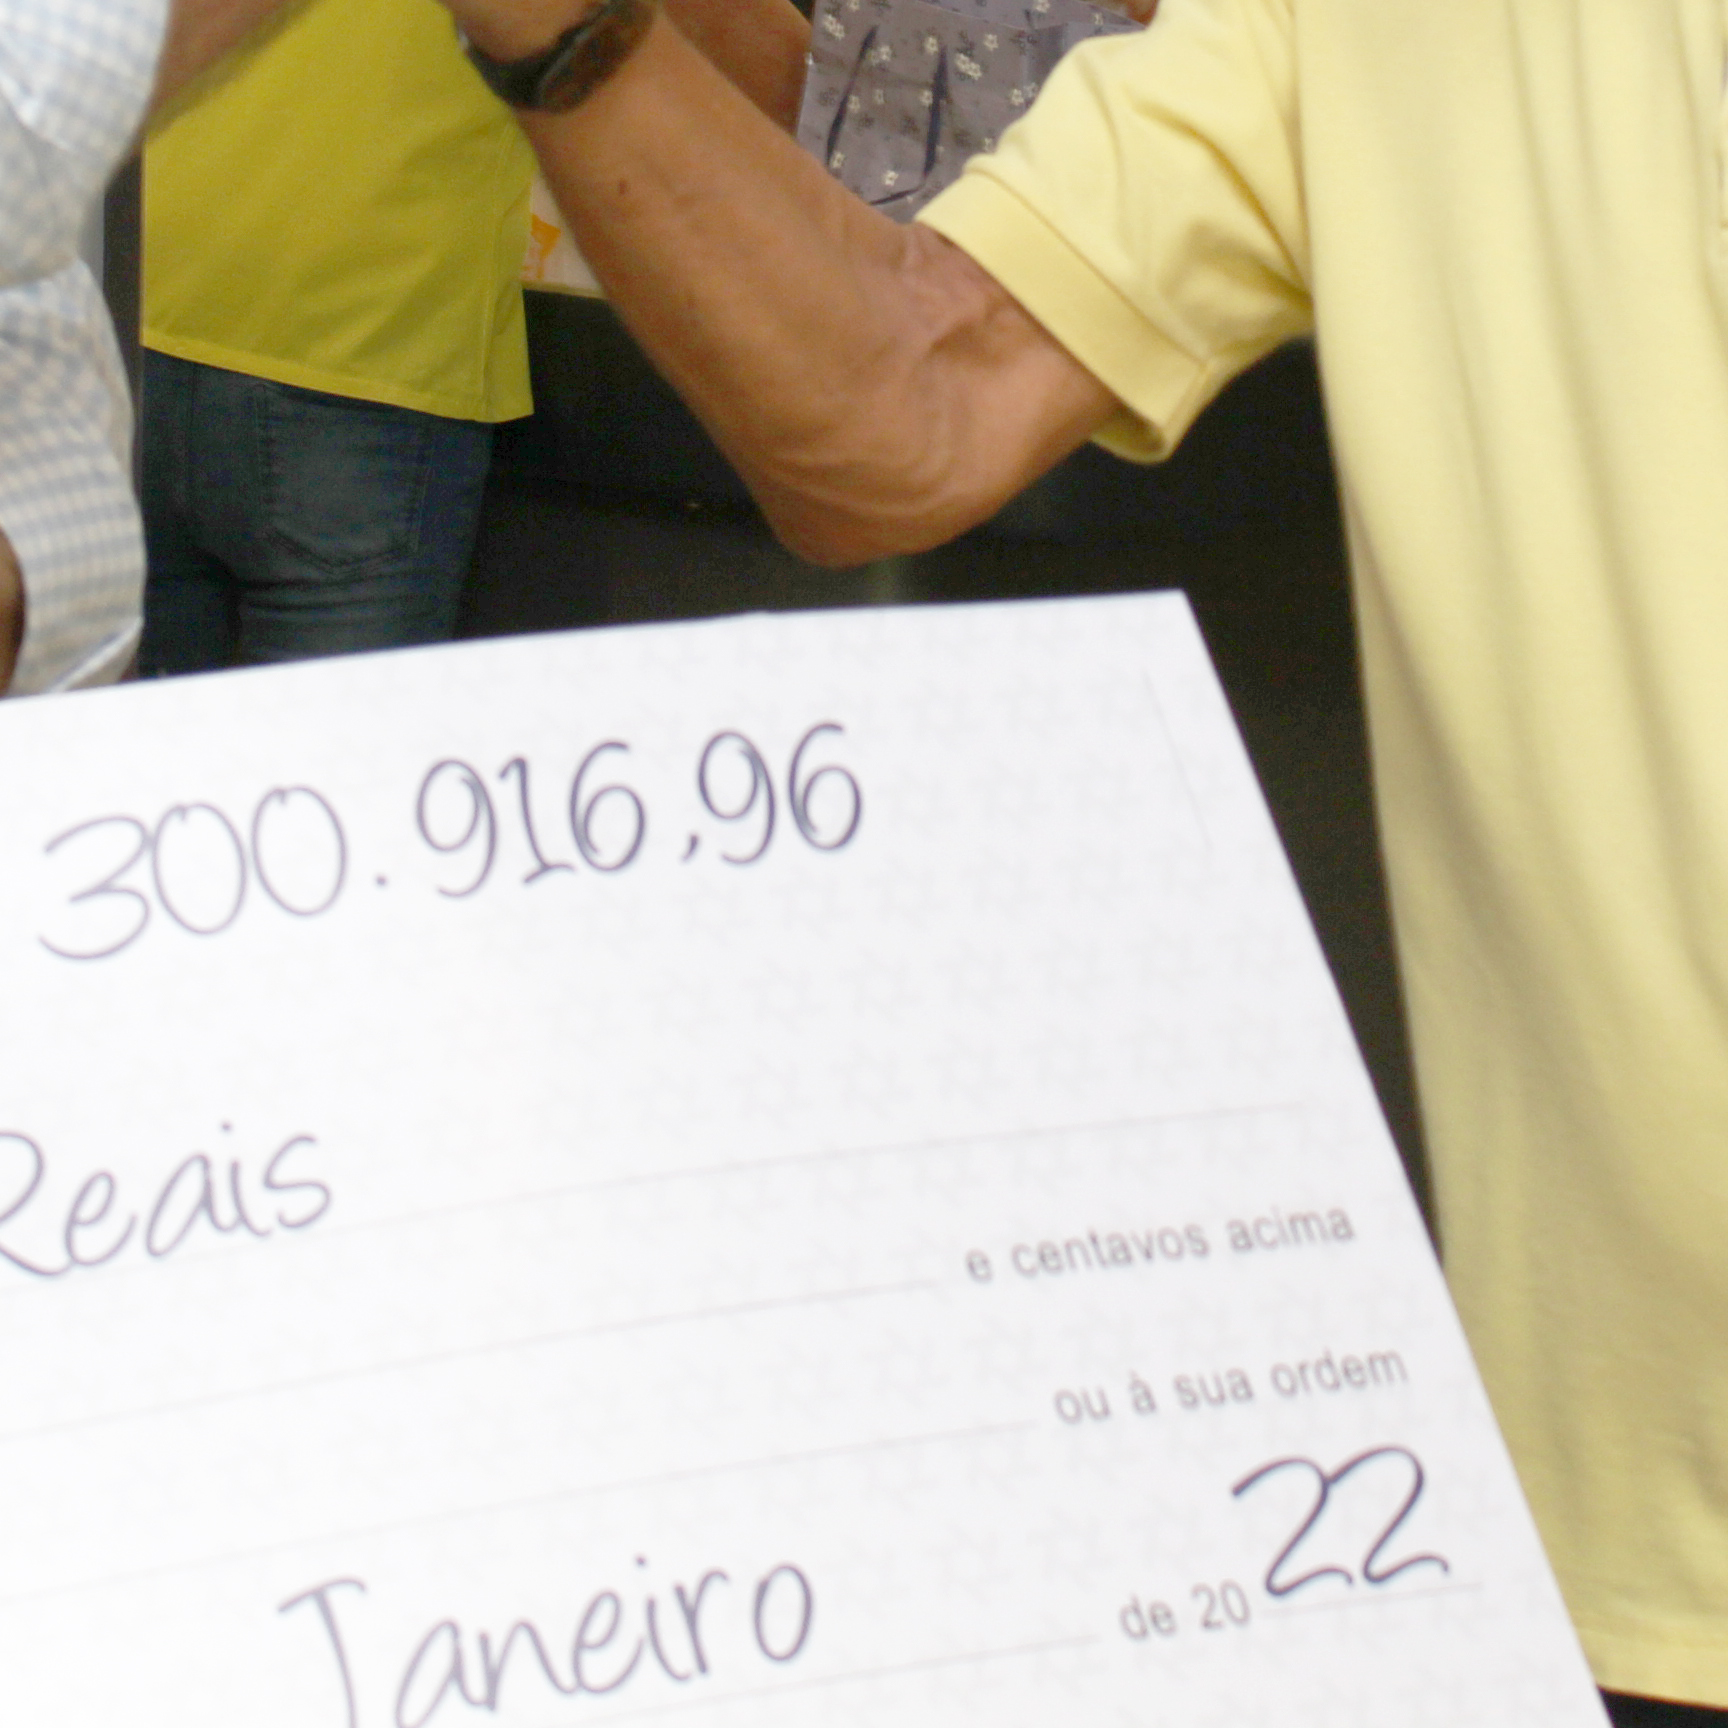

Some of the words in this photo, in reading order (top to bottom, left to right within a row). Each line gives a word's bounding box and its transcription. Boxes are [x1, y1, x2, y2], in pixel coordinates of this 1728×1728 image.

[965, 1248, 994, 1283] e
[1010, 1217, 1212, 1279] centavos
[1228, 1203, 1357, 1253] acima
[1053, 1387, 1112, 1426] ou
[1128, 1371, 1158, 1416] à
[1172, 1365, 1254, 1410] sua
[1269, 1345, 1409, 1398] ordem
[1119, 1592, 1177, 1642] de
[1190, 1579, 1251, 1632] 20
[1229, 1443, 1452, 1597] 22
